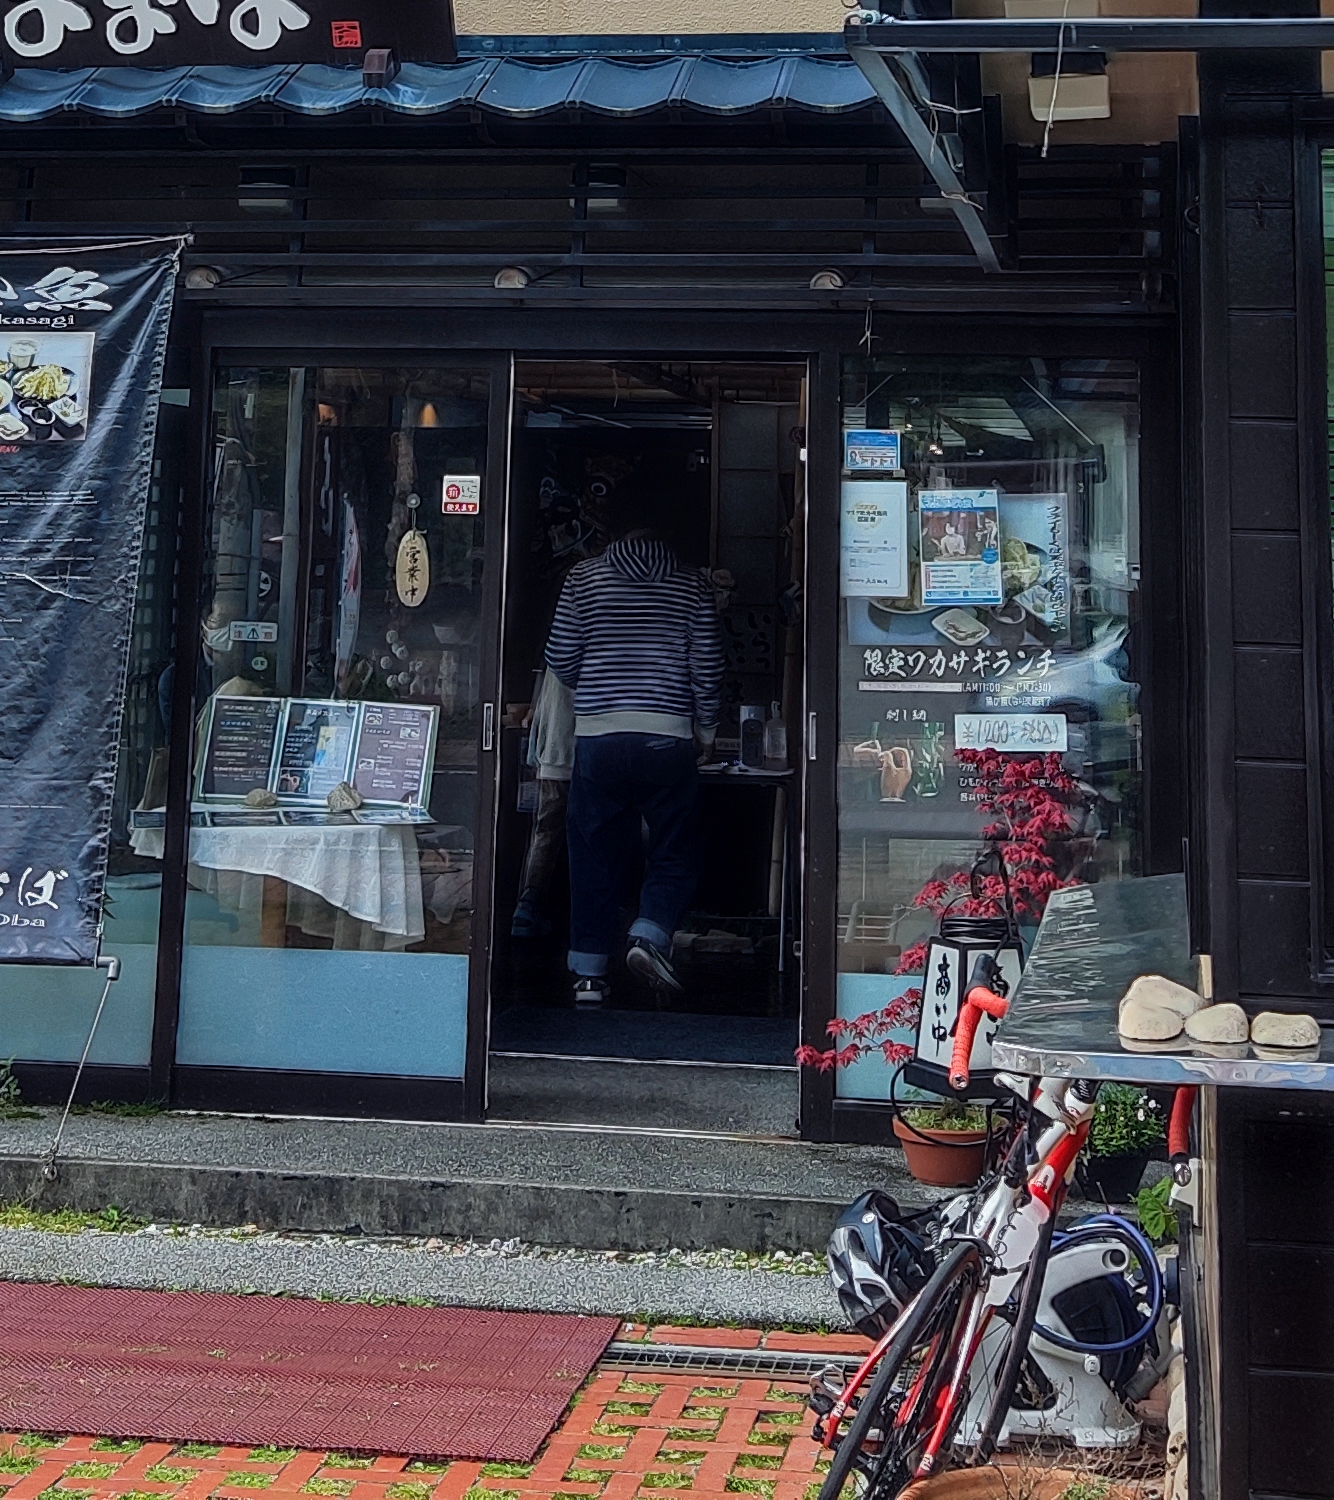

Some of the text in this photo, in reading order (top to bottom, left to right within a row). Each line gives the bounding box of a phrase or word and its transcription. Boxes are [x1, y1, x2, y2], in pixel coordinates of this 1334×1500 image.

[863, 648, 1057, 678] 限定ワカサギランチ
